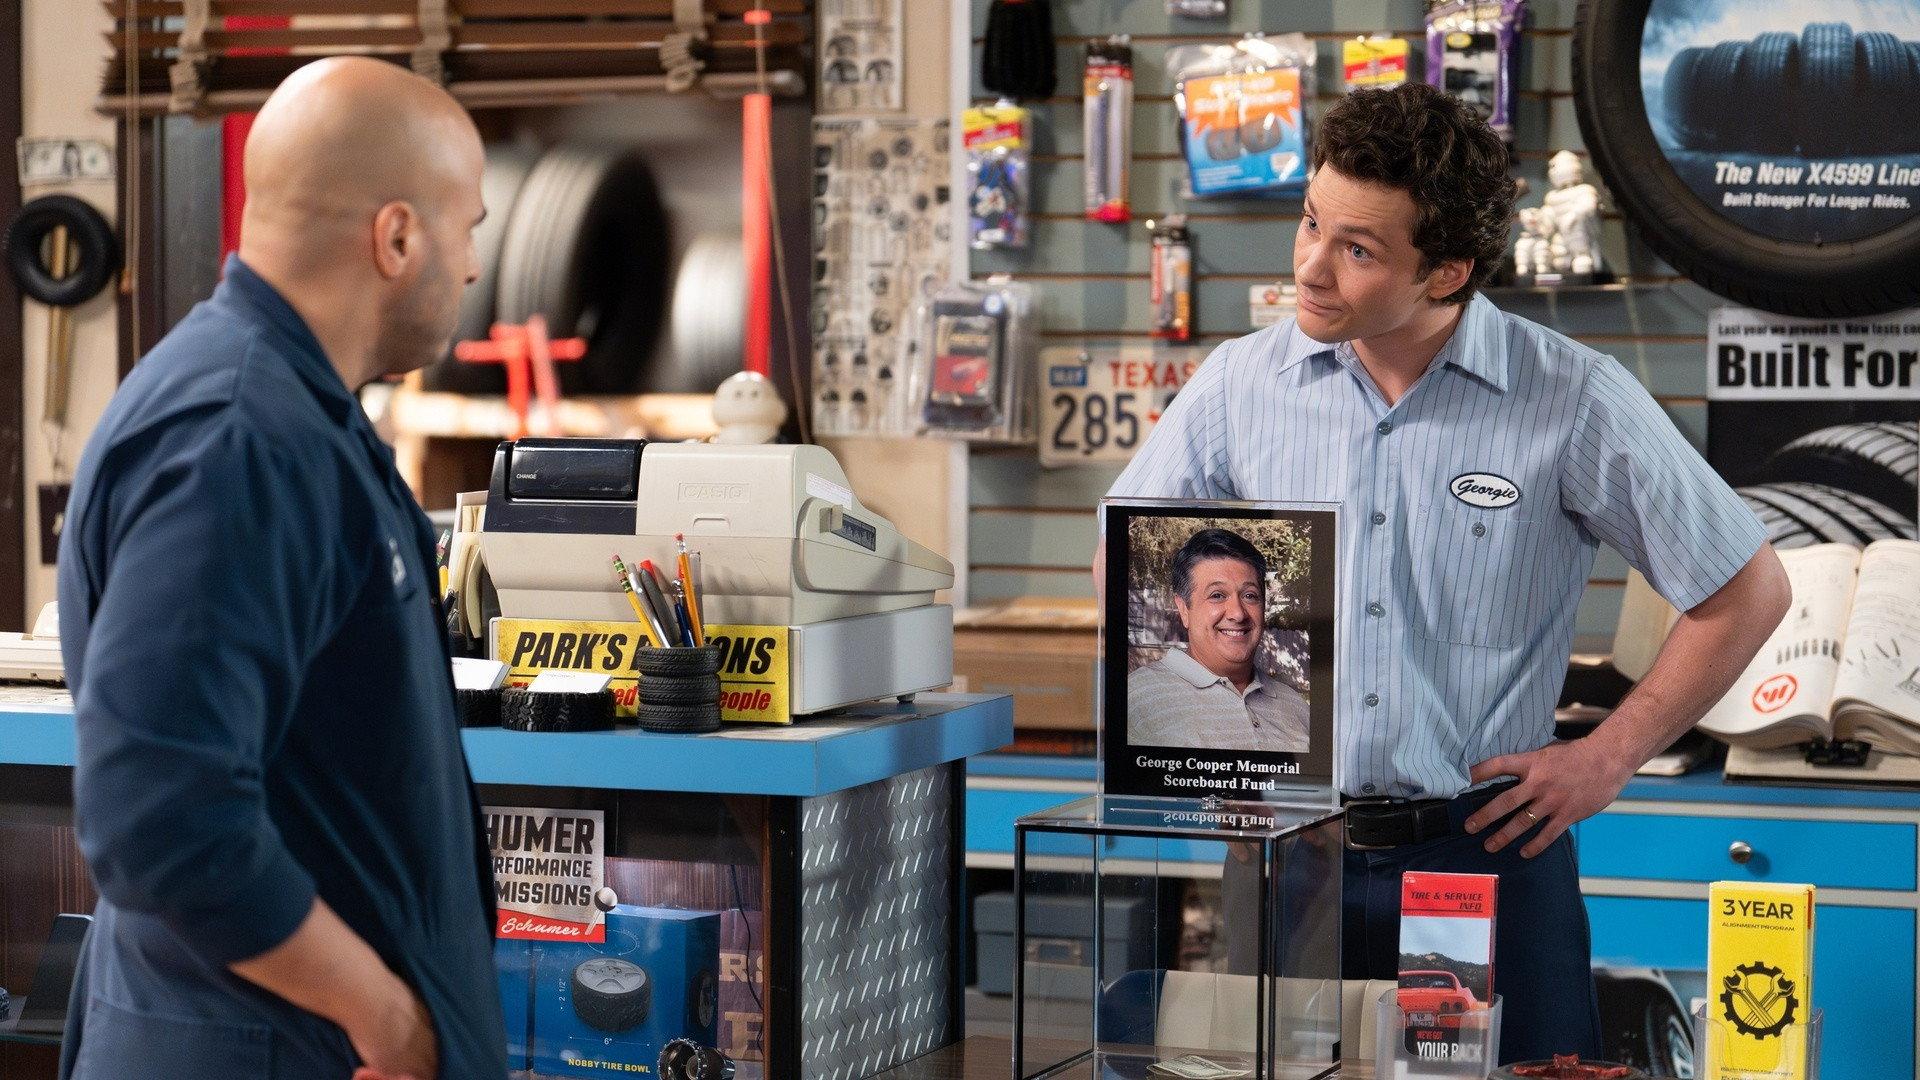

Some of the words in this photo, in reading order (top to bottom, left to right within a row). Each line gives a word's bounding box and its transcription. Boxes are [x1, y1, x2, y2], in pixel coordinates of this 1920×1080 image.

[1715, 162, 1752, 184] The
[1757, 162, 1803, 185] New
[1806, 162, 1874, 186] X4599
[1877, 163, 1920, 186] Line
[1722, 192, 1752, 208] Built
[1754, 193, 1805, 210] Stronger
[1806, 193, 1828, 208] For
[1829, 193, 1871, 210] Longer
[1718, 344, 1830, 388] Built
[1844, 344, 1918, 388] For
[1053, 392, 1138, 449] 285
[1457, 479, 1516, 501] Georgie
[510, 631, 628, 671] PARK'S
[1136, 756, 1182, 771] George
[1186, 758, 1233, 773] Cooper
[1236, 760, 1300, 775] Memorial
[1164, 775, 1237, 790] Scoreboard
[1241, 778, 1275, 791] Fund
[481, 814, 595, 855] HUMER
[1411, 892, 1431, 900] TIRE
[1434, 892, 1441, 900] &
[1444, 892, 1484, 902] SERVICE
[1459, 902, 1482, 911] INFO
[1723, 899, 1736, 916] 3
[1738, 899, 1794, 920] YEAR
[502, 917, 580, 936] Schumer
[1761, 924, 1795, 932] PROGRAM
[1416, 1041, 1448, 1060] YOUR
[568, 1058, 600, 1069] NOBBY
[602, 1061, 623, 1071] TIRE
[624, 1063, 651, 1074] BOWL
